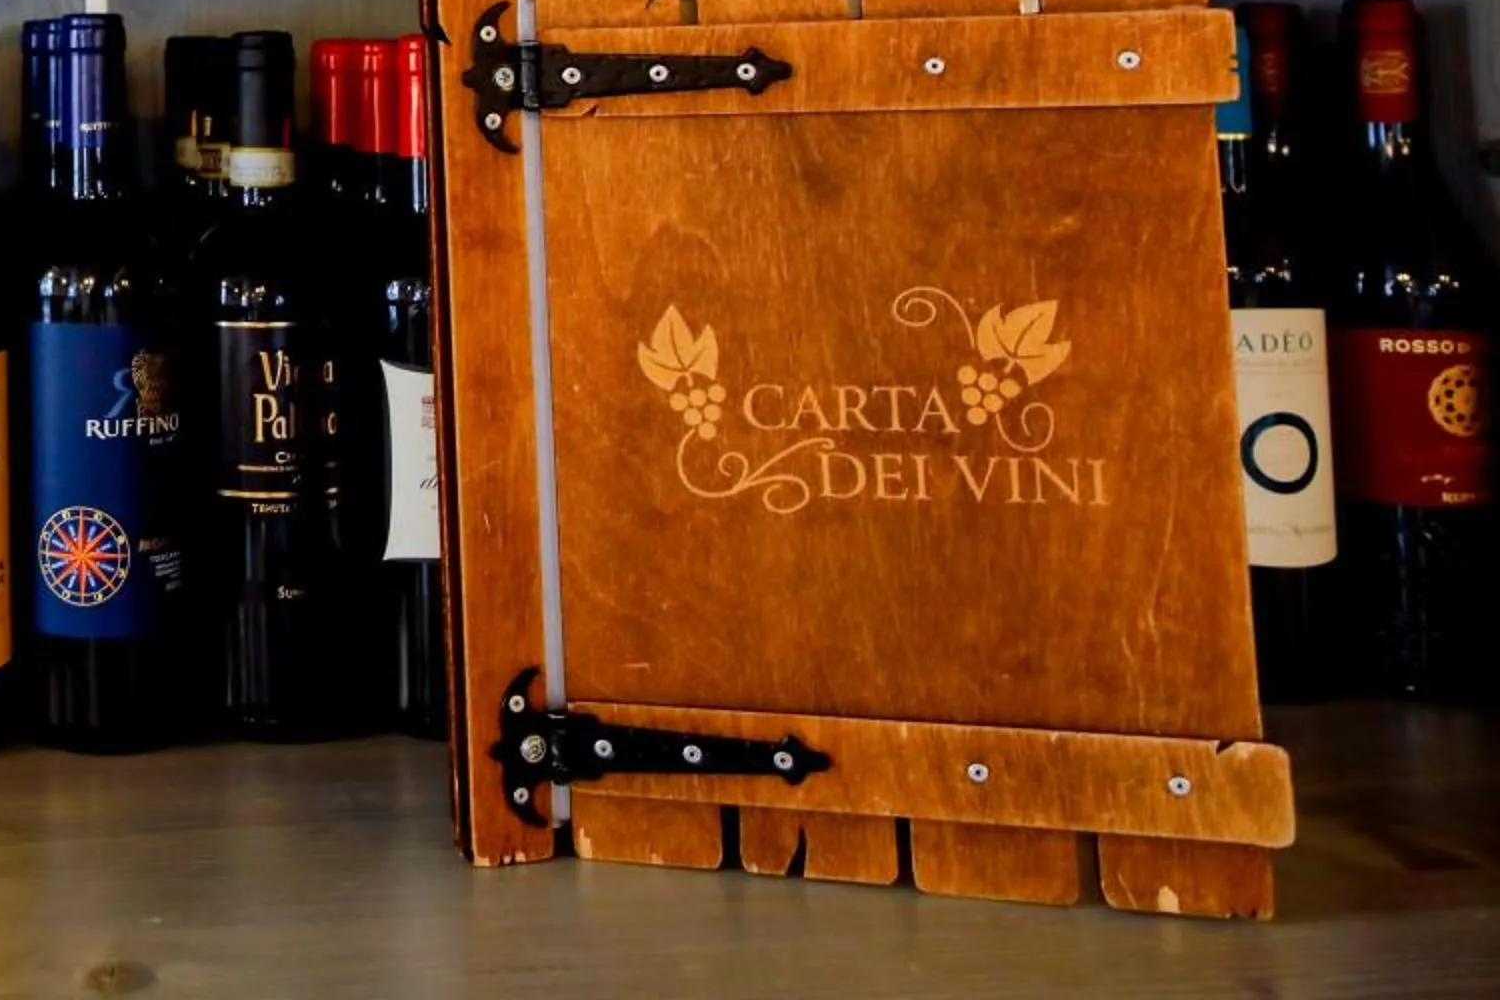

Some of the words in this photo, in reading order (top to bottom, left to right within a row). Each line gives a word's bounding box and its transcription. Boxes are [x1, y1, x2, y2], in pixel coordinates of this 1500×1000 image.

[1379, 337, 1455, 355] ROSSO
[85, 411, 180, 441] RUFFINO
[742, 383, 962, 434] CARTA
[815, 450, 933, 500] DEI
[952, 453, 1113, 507] VINI
